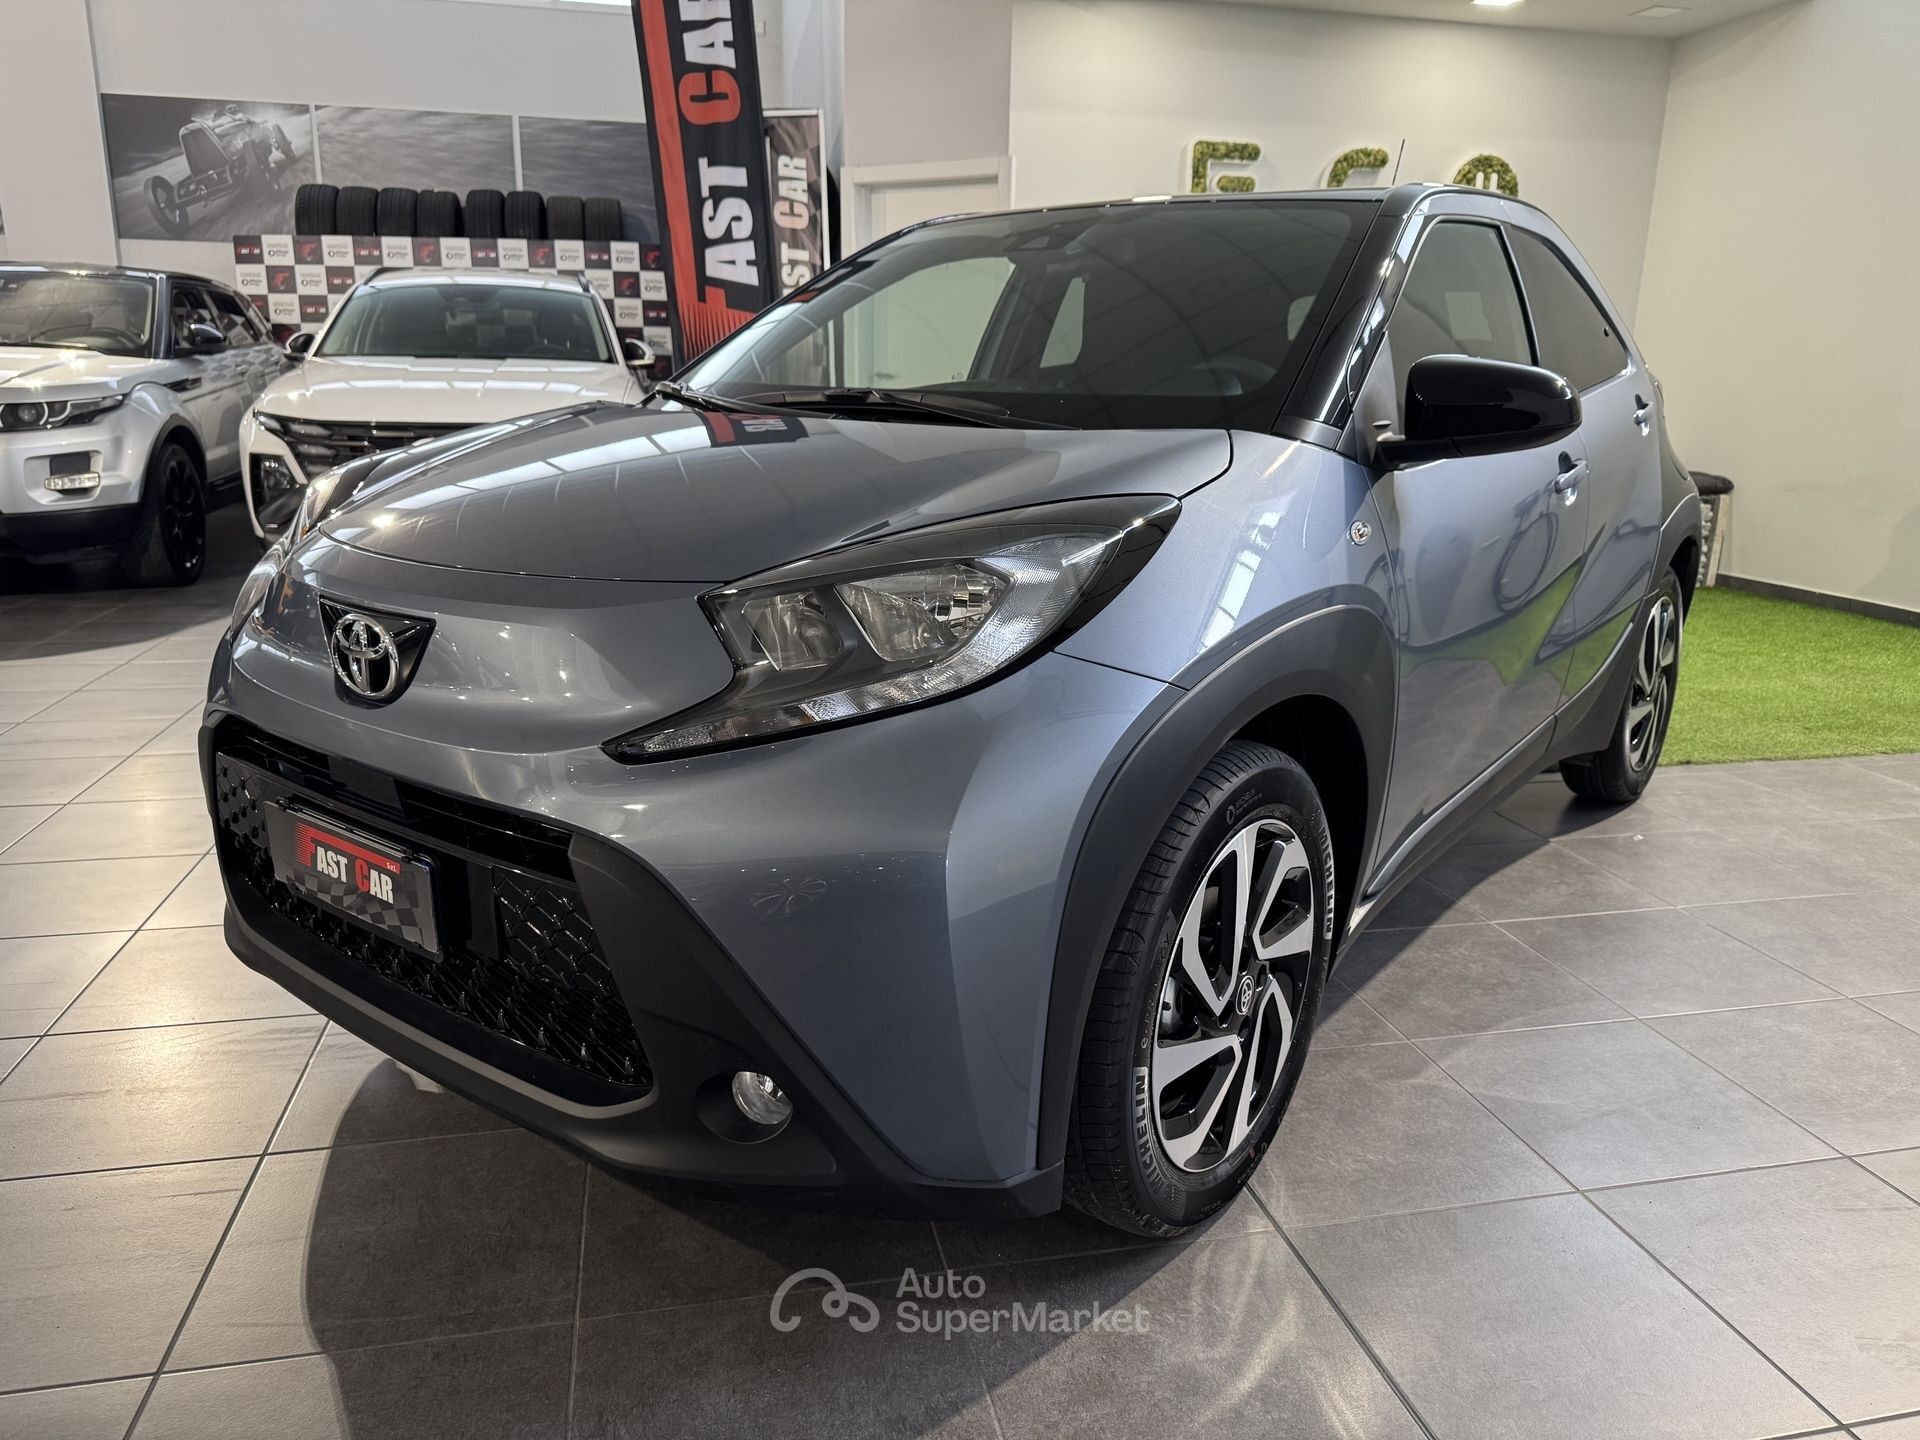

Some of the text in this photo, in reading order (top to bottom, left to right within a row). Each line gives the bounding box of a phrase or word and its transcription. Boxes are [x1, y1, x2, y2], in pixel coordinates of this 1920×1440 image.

[772, 154, 810, 231] CAR
[295, 821, 394, 905] FAST CAR
[1318, 824, 1335, 933] MICHELIN
[1134, 1075, 1165, 1193] MICHELIN
